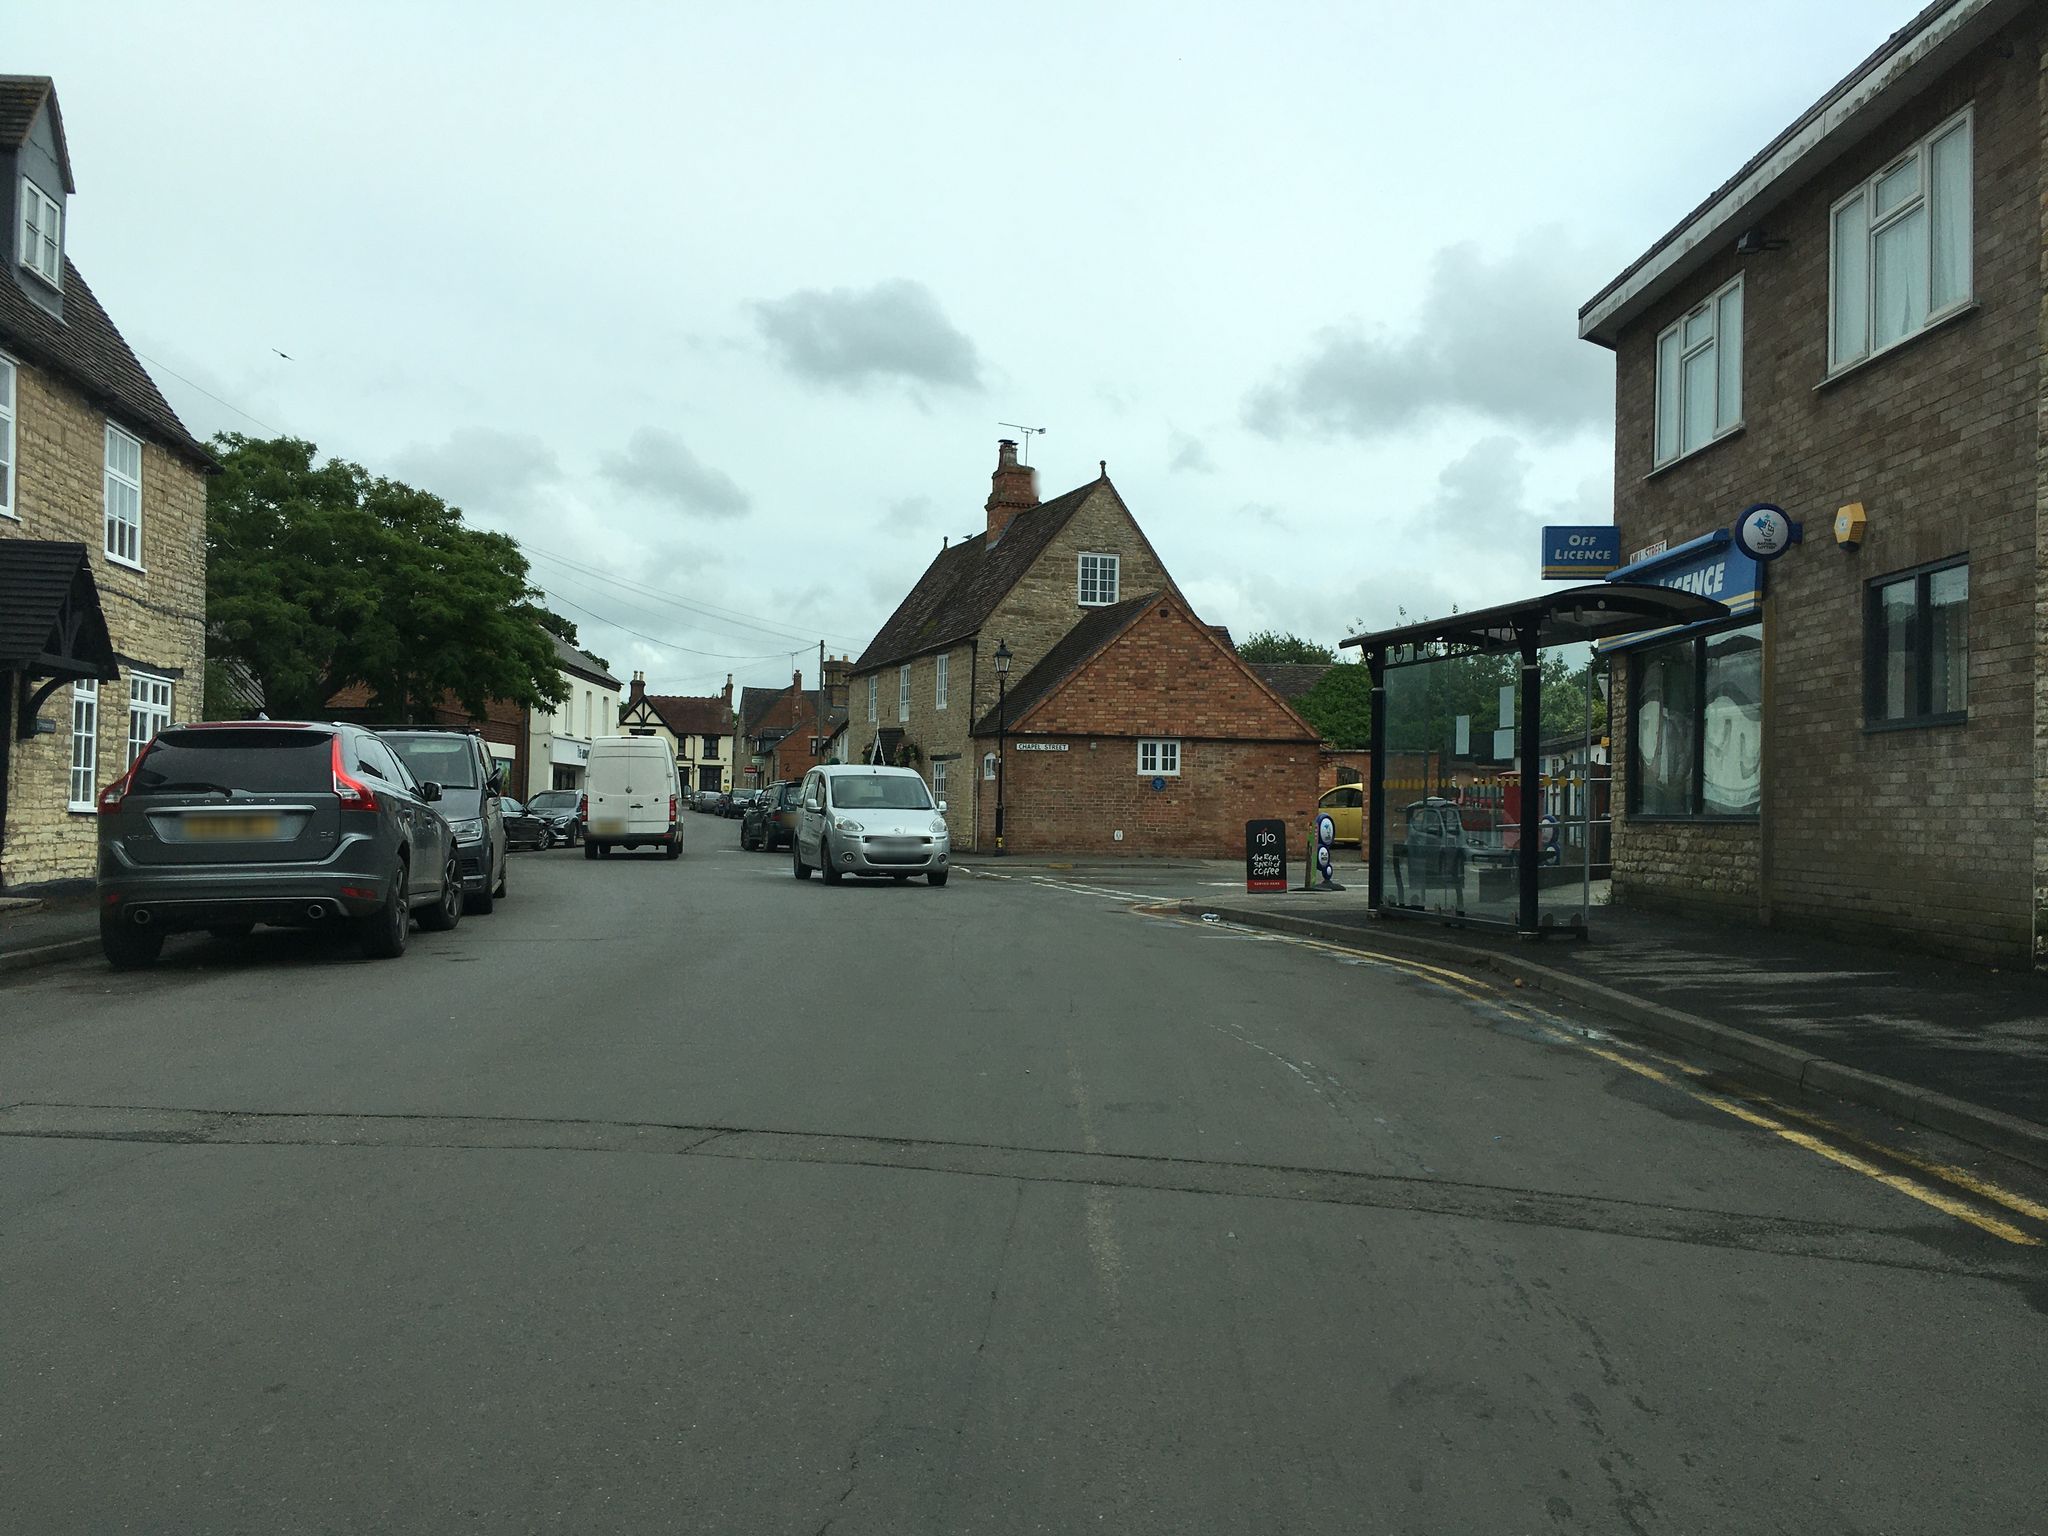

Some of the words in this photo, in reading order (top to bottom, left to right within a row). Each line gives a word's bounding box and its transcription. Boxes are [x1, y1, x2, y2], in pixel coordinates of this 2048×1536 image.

[1568, 534, 1597, 546] OFF
[1554, 548, 1612, 560] LICENCE
[1044, 743, 1066, 751] STREET
[1253, 866, 1280, 876] coffee
